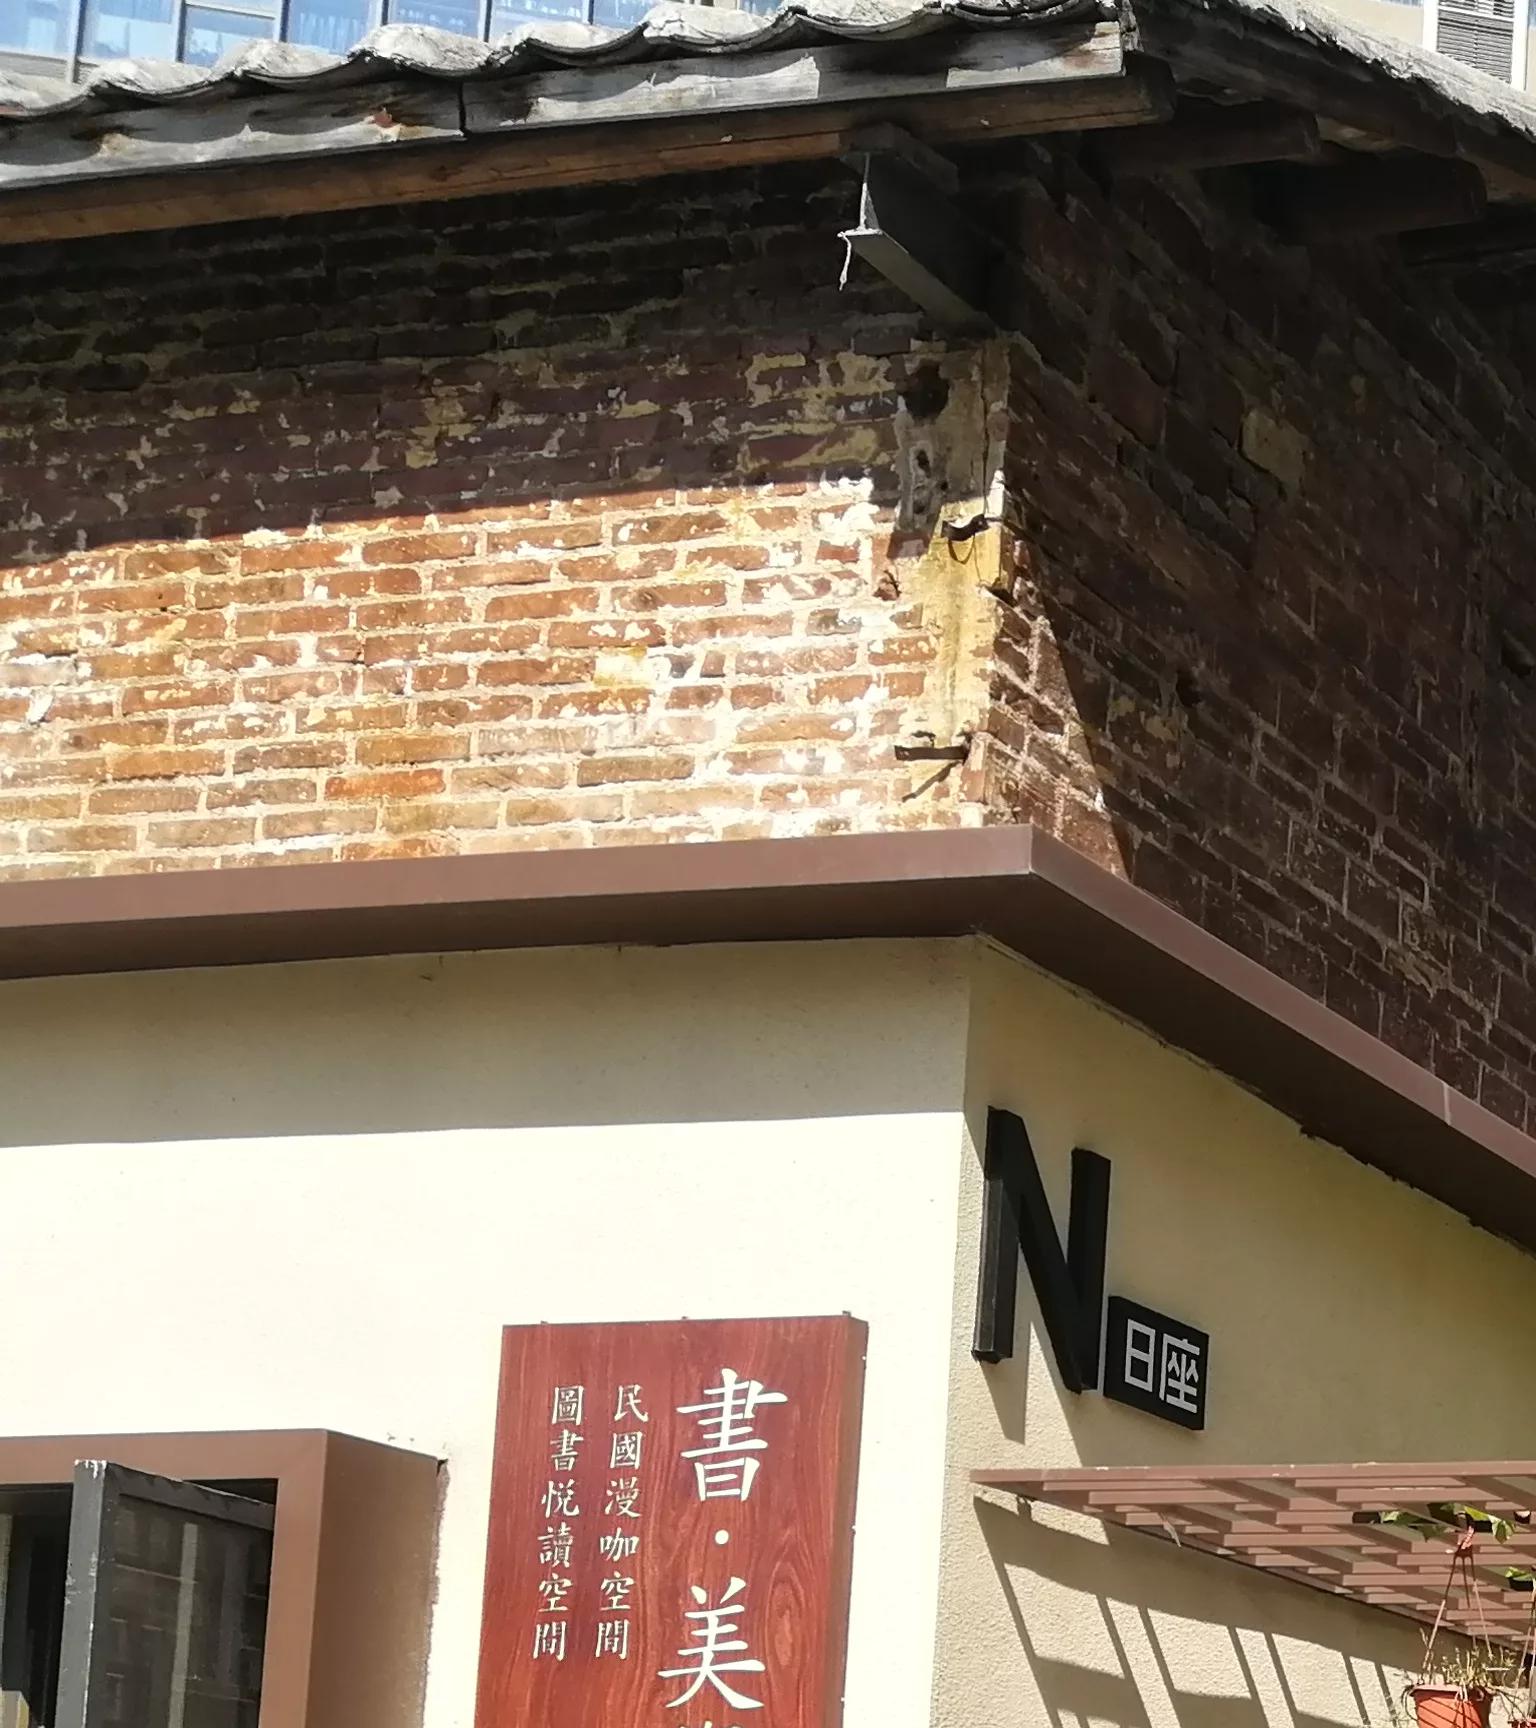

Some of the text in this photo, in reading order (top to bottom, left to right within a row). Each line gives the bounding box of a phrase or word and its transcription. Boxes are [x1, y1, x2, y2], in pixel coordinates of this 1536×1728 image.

[596, 1385, 648, 1661] 民國漫咖空間
